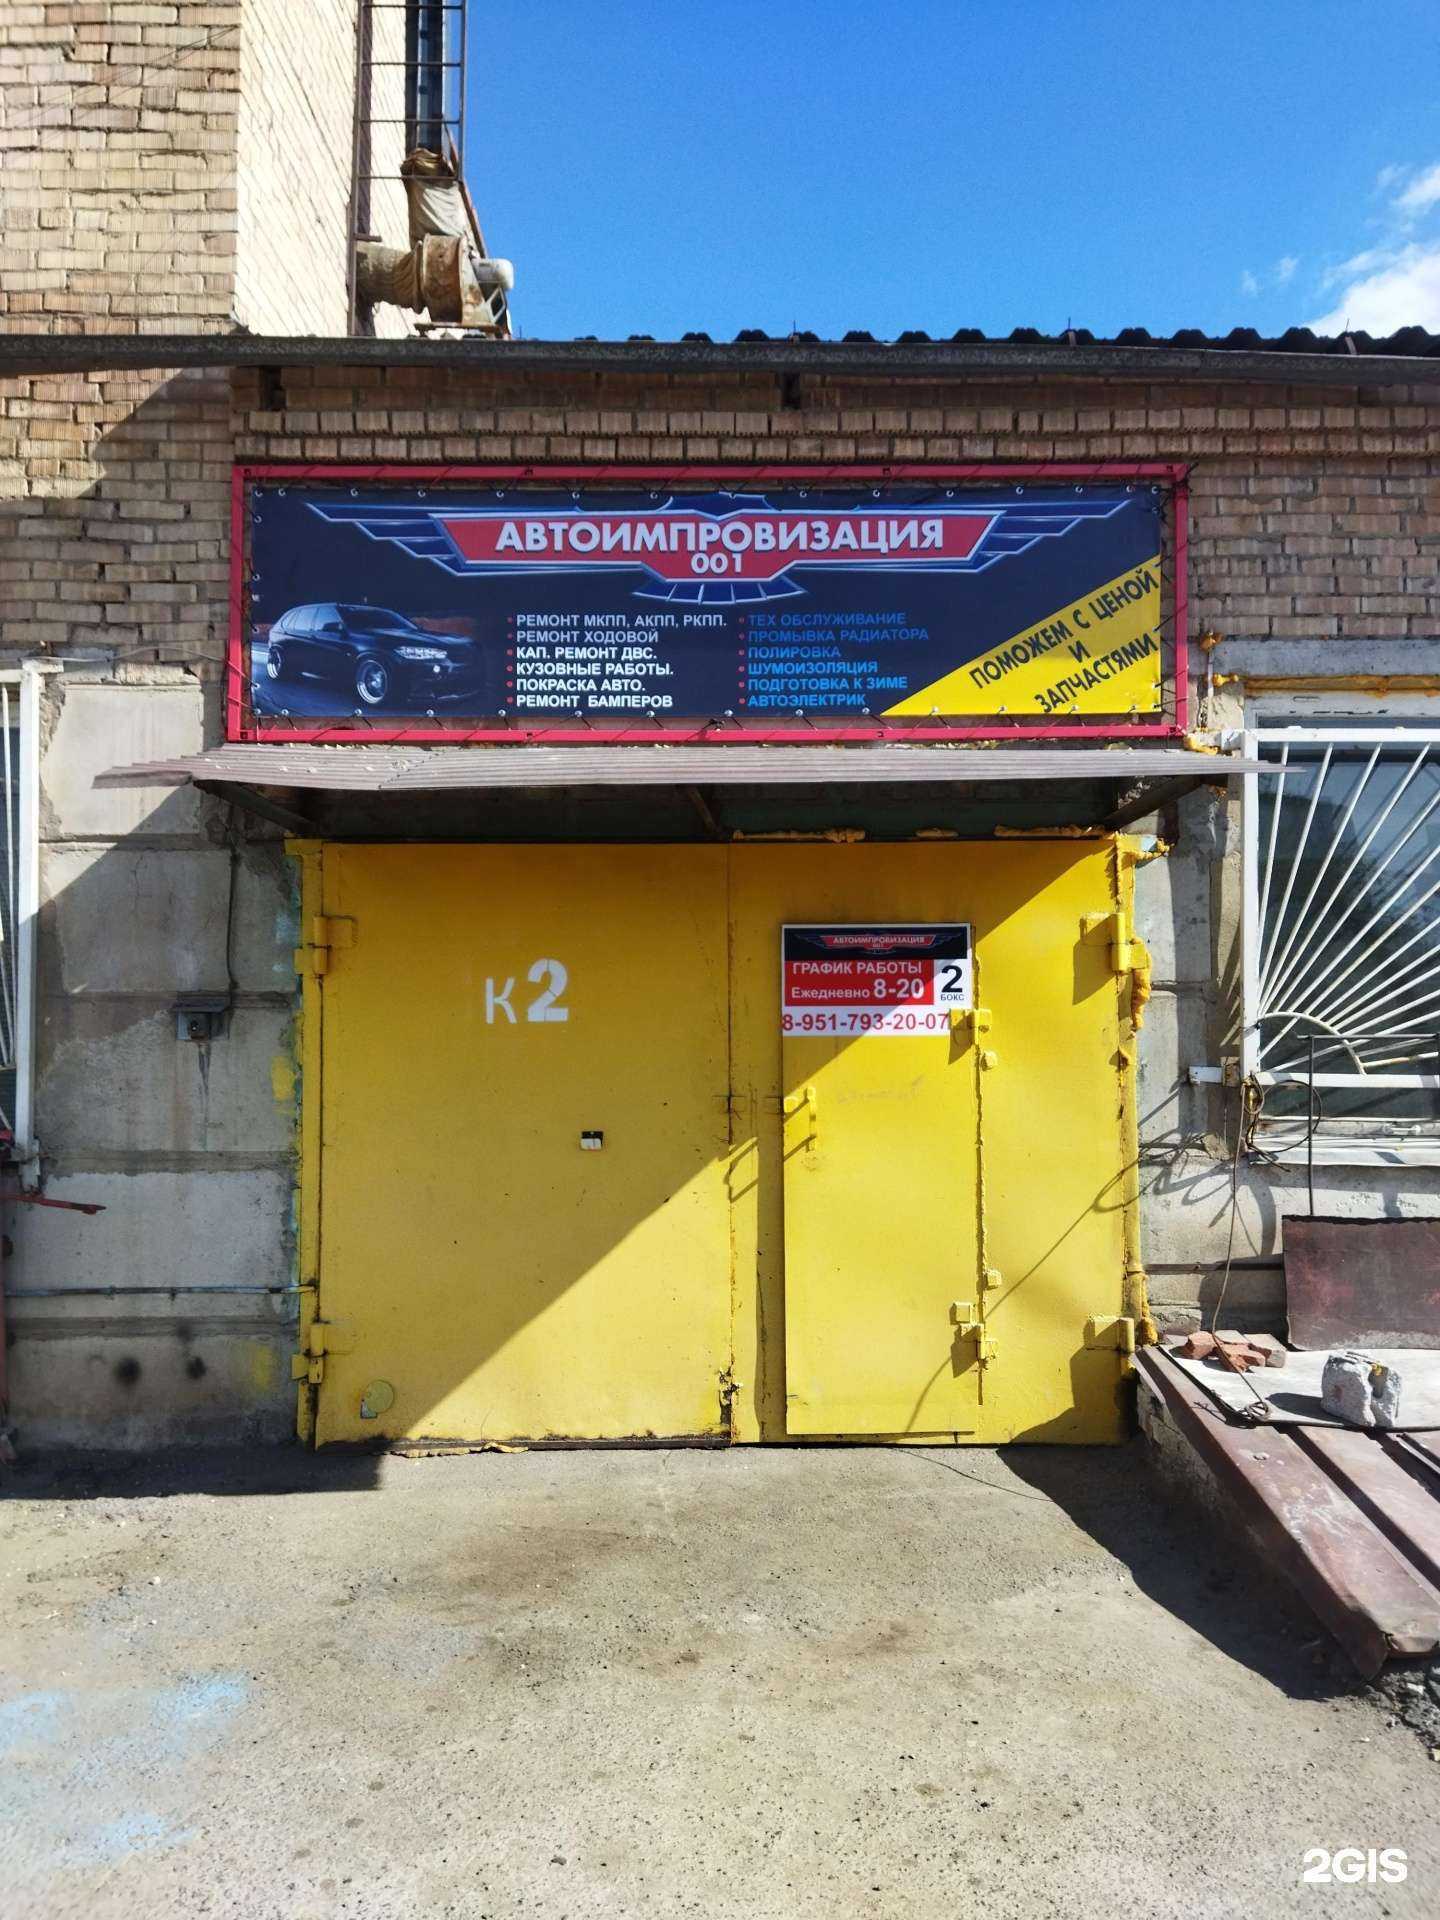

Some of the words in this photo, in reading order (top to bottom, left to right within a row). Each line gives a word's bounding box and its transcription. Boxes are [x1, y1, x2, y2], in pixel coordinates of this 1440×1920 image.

[495, 519, 944, 553] АВТОИМПРОВИЗАЦИЯ
[690, 552, 743, 574] 001
[516, 615, 580, 626] РЕМОНТ
[584, 615, 630, 628] МКПП,
[634, 615, 679, 628] АКПП,
[683, 615, 727, 626] РКПП.
[749, 615, 776, 627] ТЕХ
[780, 612, 907, 627] ОБСЛУЖИВАНИЕ
[516, 631, 580, 643] РЕМОНТ
[584, 628, 659, 644] ХОДОВОЙ
[749, 630, 836, 643] ПРОМЫВКА
[840, 628, 929, 643] РАДИАТОРА
[969, 619, 1074, 689] ПОМОЖЕМ
[1072, 608, 1091, 629] С
[1088, 568, 1159, 621] ЦЕНОЙ
[516, 647, 550, 659] КАП.
[555, 647, 618, 659] РЕМОНТ
[621, 647, 657, 661] ДВС.
[749, 646, 841, 658] ПОЛИРОВКА
[1068, 639, 1092, 663] И
[516, 663, 601, 675] КУЗОВНЫЕ
[605, 663, 674, 675] РАБОТЫ.
[748, 661, 878, 675] ШУМОИЗОЛЯЦИЯ
[1033, 632, 1160, 714] ЗАПЧАСТЯМИ
[516, 679, 598, 691] ПОКРАСКА
[601, 679, 646, 691] АВТО.
[748, 678, 850, 692] ПОДГОТОВКА
[854, 678, 863, 690] К
[867, 676, 908, 689] ЗИМЕ
[516, 695, 580, 708] РЕМОНТ
[588, 695, 673, 708] БАМПЕРОВ
[748, 694, 866, 708] АВТОЭЛЕКТРИК
[793, 962, 852, 975] ГРАФИК
[857, 961, 922, 974] РАБОТЫ
[941, 965, 963, 993] 2
[792, 986, 870, 999] Ежедневно
[873, 978, 924, 999] 8-20
[782, 1013, 949, 1031] 8-951-793-20-07
